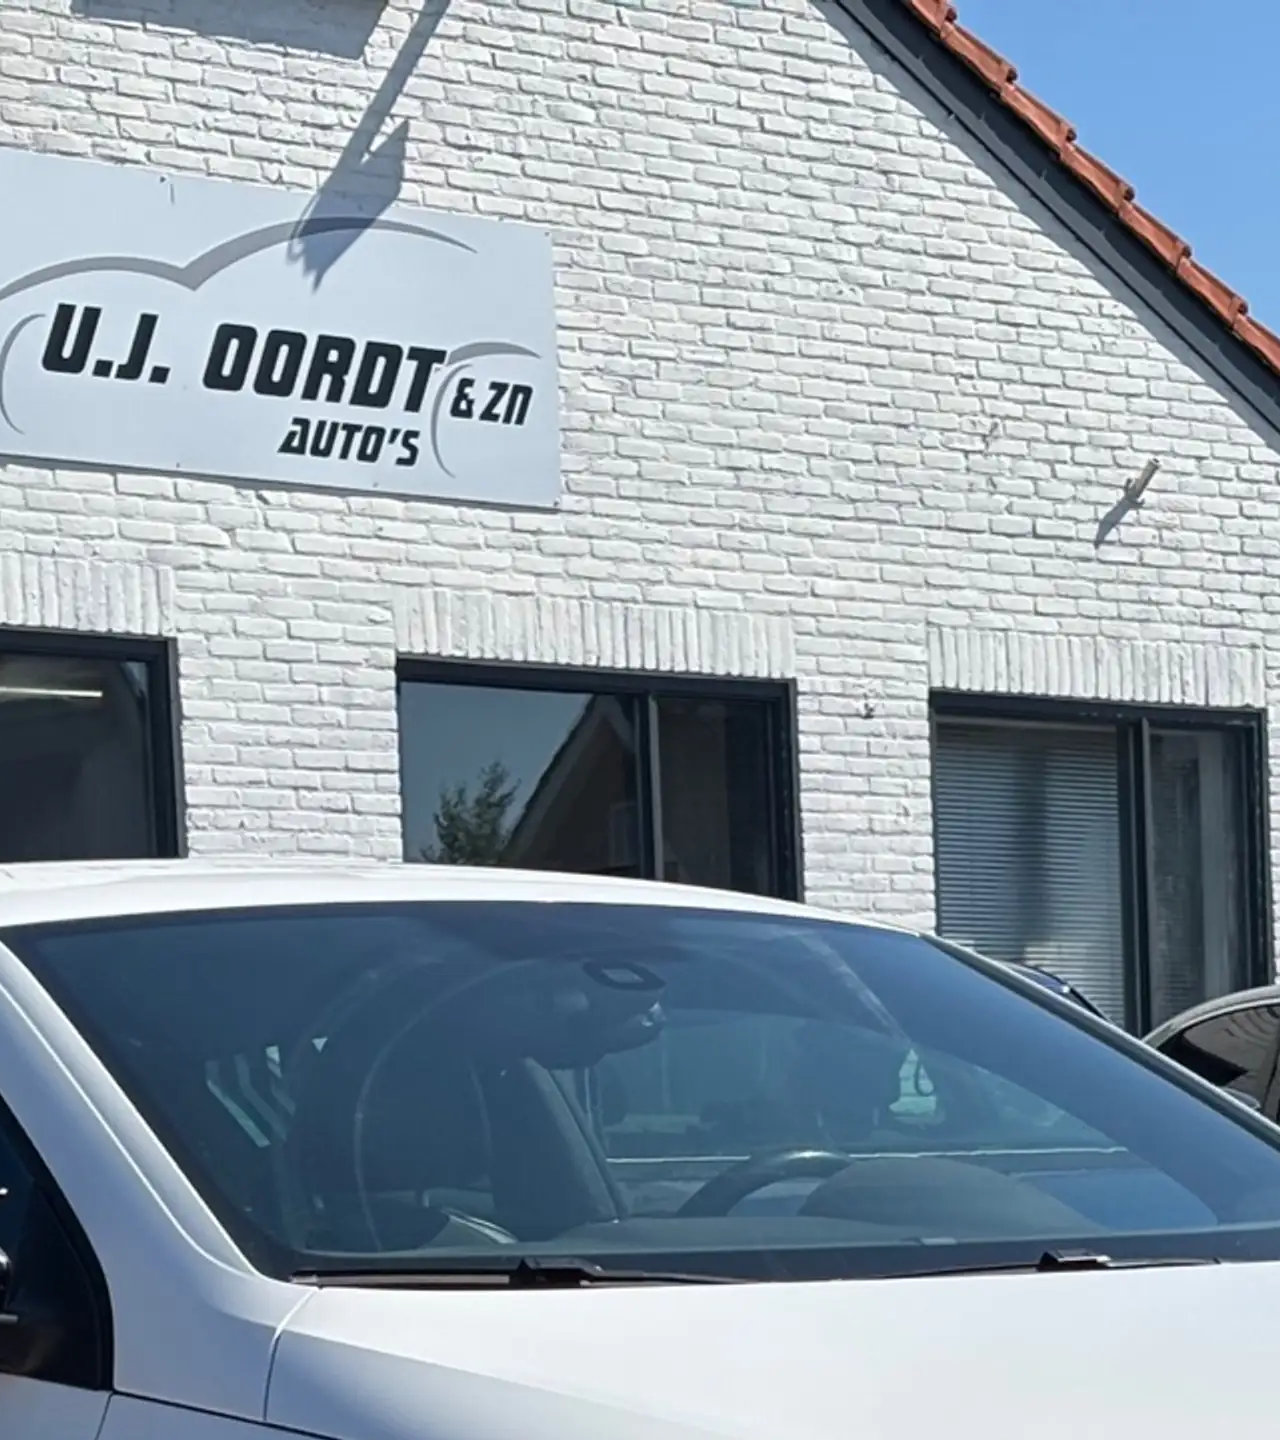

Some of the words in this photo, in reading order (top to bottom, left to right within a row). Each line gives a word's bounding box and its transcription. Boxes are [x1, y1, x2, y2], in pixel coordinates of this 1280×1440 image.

[42, 302, 171, 384] U.J.
[202, 322, 446, 414] OORDT
[449, 377, 476, 421] &
